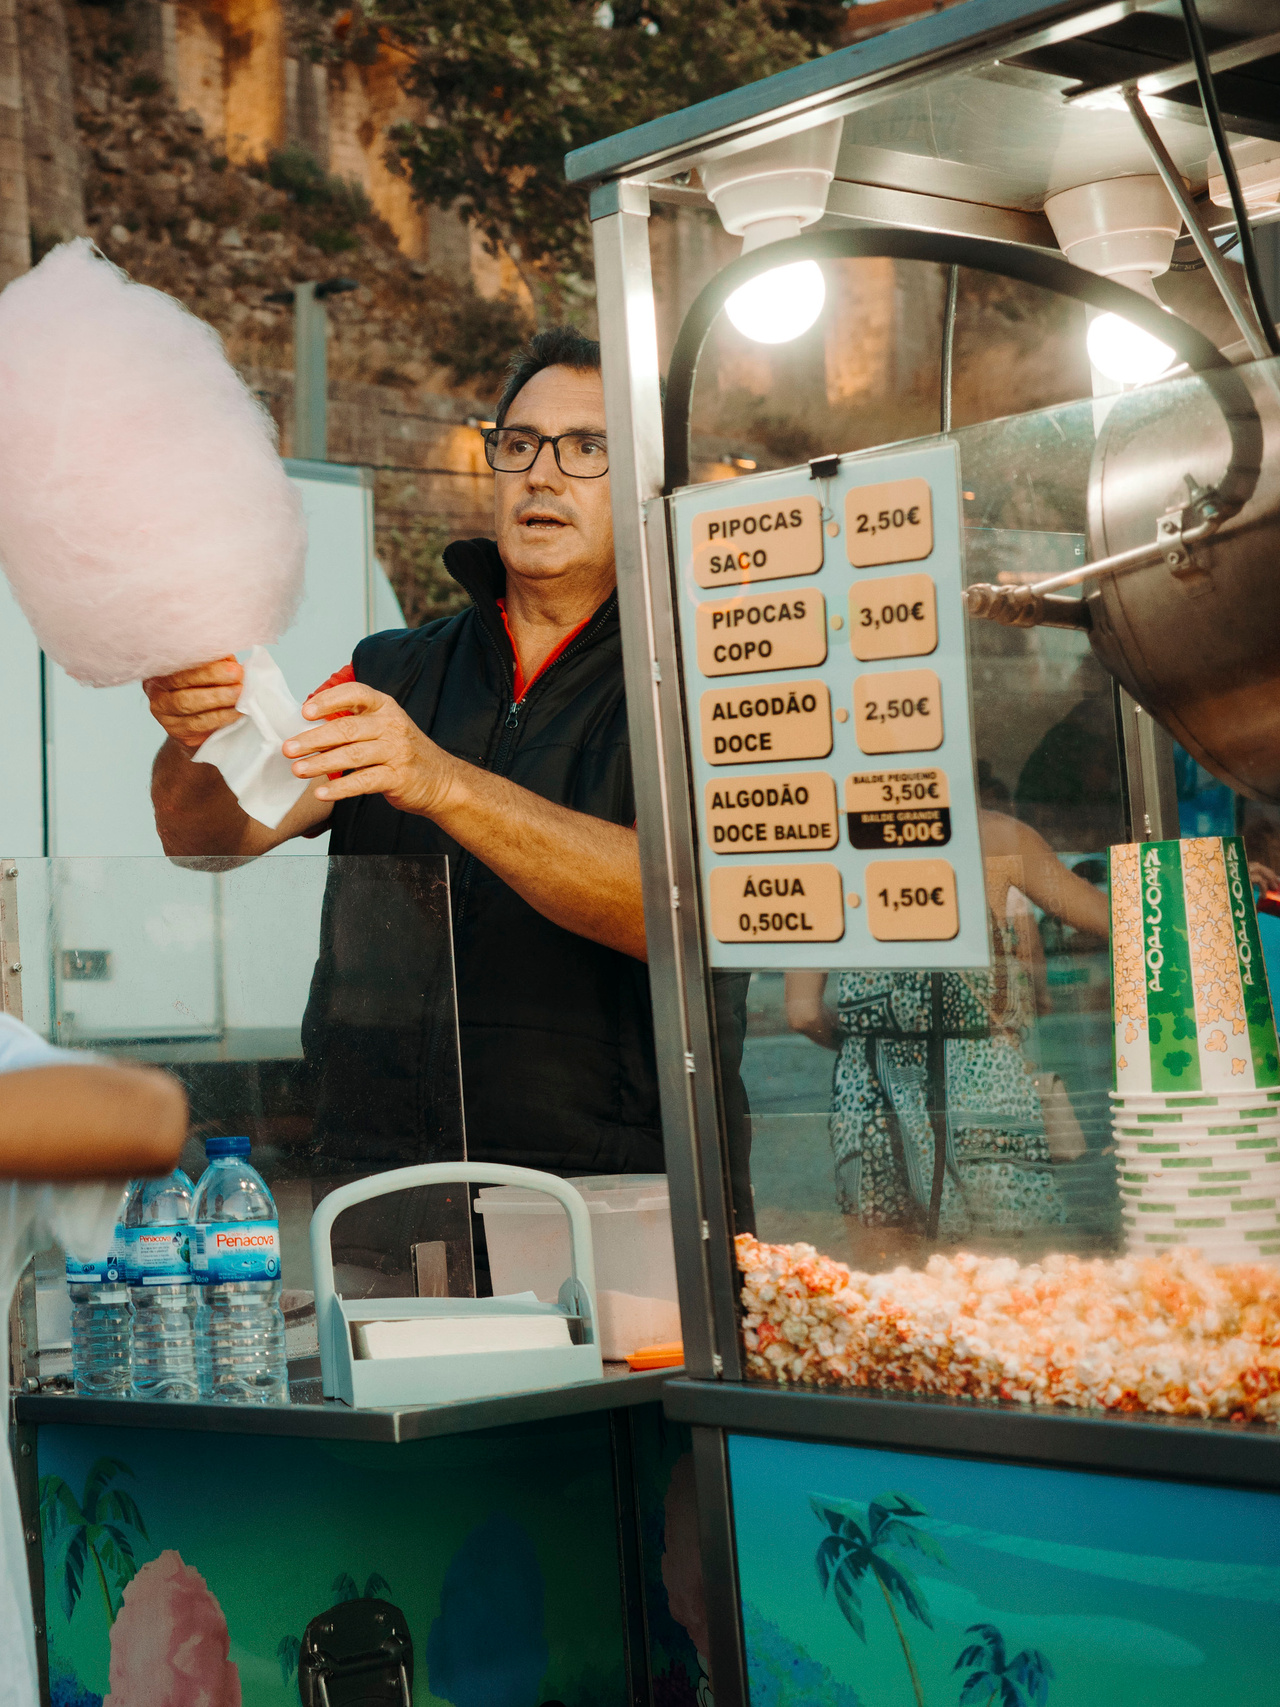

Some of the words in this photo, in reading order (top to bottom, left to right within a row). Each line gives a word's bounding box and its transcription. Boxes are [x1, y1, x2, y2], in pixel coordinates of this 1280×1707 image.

[707, 508, 803, 540] PIPOCAS
[855, 506, 921, 536] 2,50€
[709, 550, 767, 574] SACO
[711, 601, 806, 630] PIPOCAS
[860, 601, 924, 629] 3,00€
[713, 640, 772, 664] COPO
[711, 693, 817, 721] ALGODÃO
[865, 696, 930, 724] 2,50€
[714, 733, 772, 754] DOCE
[853, 775, 884, 784] BALDE
[888, 772, 937, 782] PEQUENO
[711, 784, 809, 809] ALGODÃO
[882, 783, 939, 804] 3,50€
[861, 813, 895, 823] BALDE
[896, 811, 940, 821] GRANDE
[713, 823, 768, 843] DOCE
[775, 823, 831, 840] BALDE
[883, 822, 944, 846] 5,00€
[742, 875, 805, 898] ÁGUA
[878, 888, 944, 910] 1,50€
[738, 912, 813, 932] 0,50CL
[1143, 848, 1164, 991] POPCORN
[1227, 842, 1254, 985] POPCORN
[217, 1234, 273, 1247] Penacova
